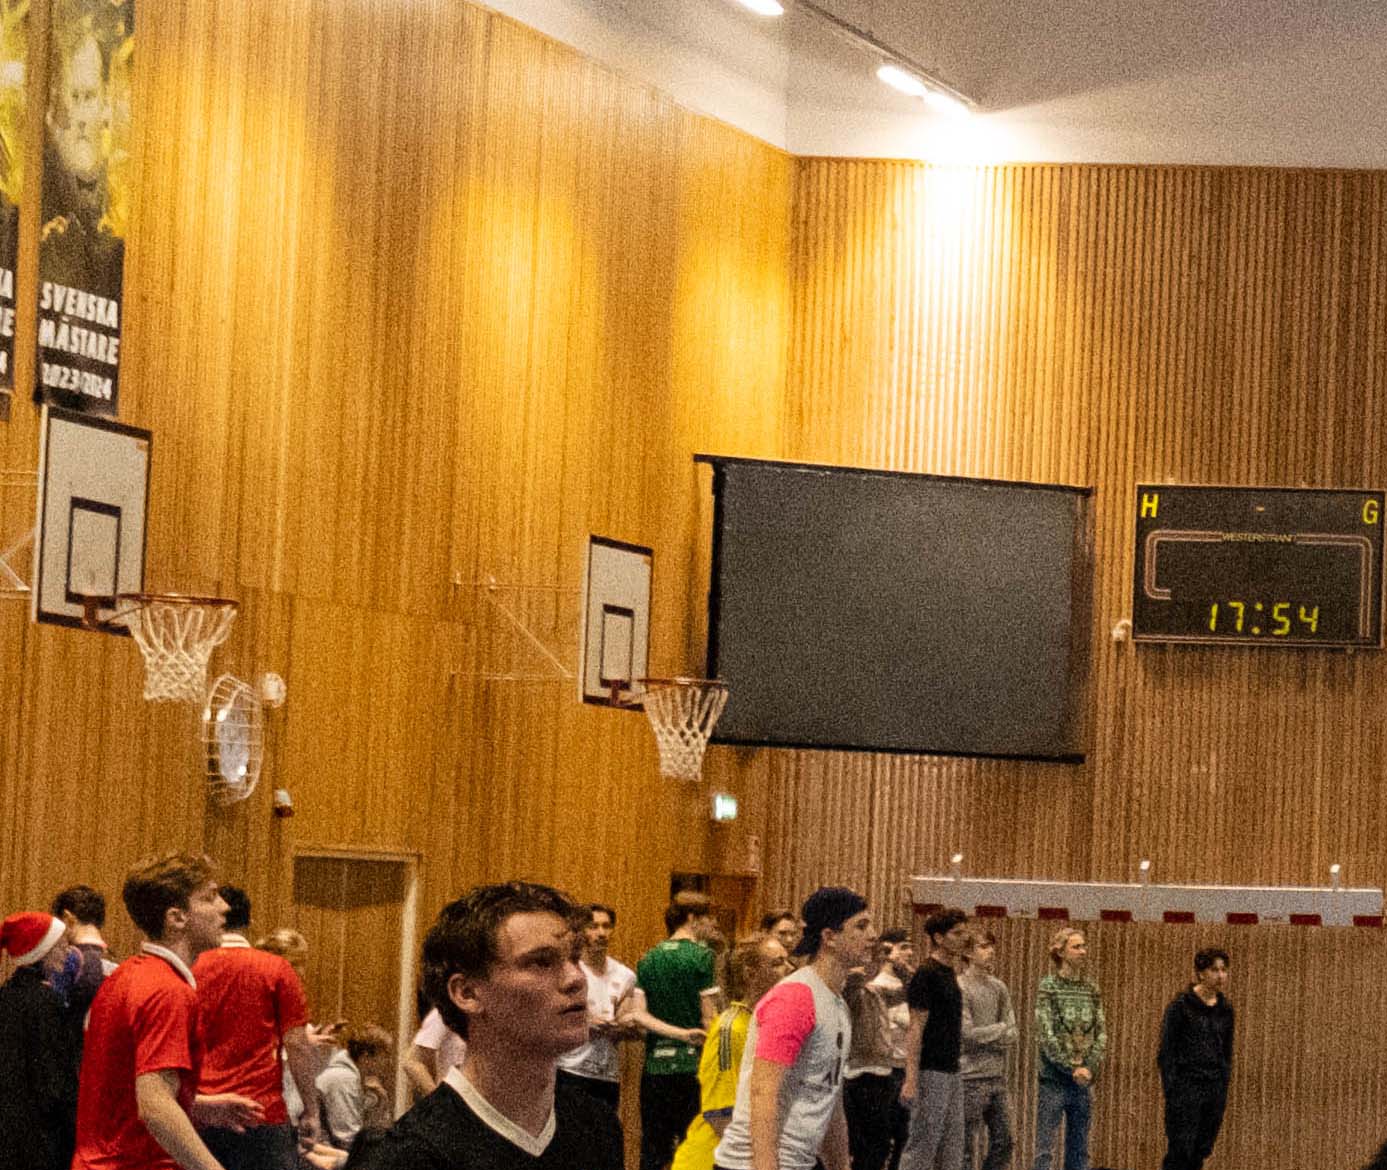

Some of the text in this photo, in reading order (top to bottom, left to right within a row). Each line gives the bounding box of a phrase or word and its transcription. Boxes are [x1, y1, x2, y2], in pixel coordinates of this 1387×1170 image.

[40, 281, 118, 329] SVENSKA
[1140, 493, 1159, 518] H
[1362, 499, 1379, 524] G
[1208, 601, 1319, 636] 17:54
